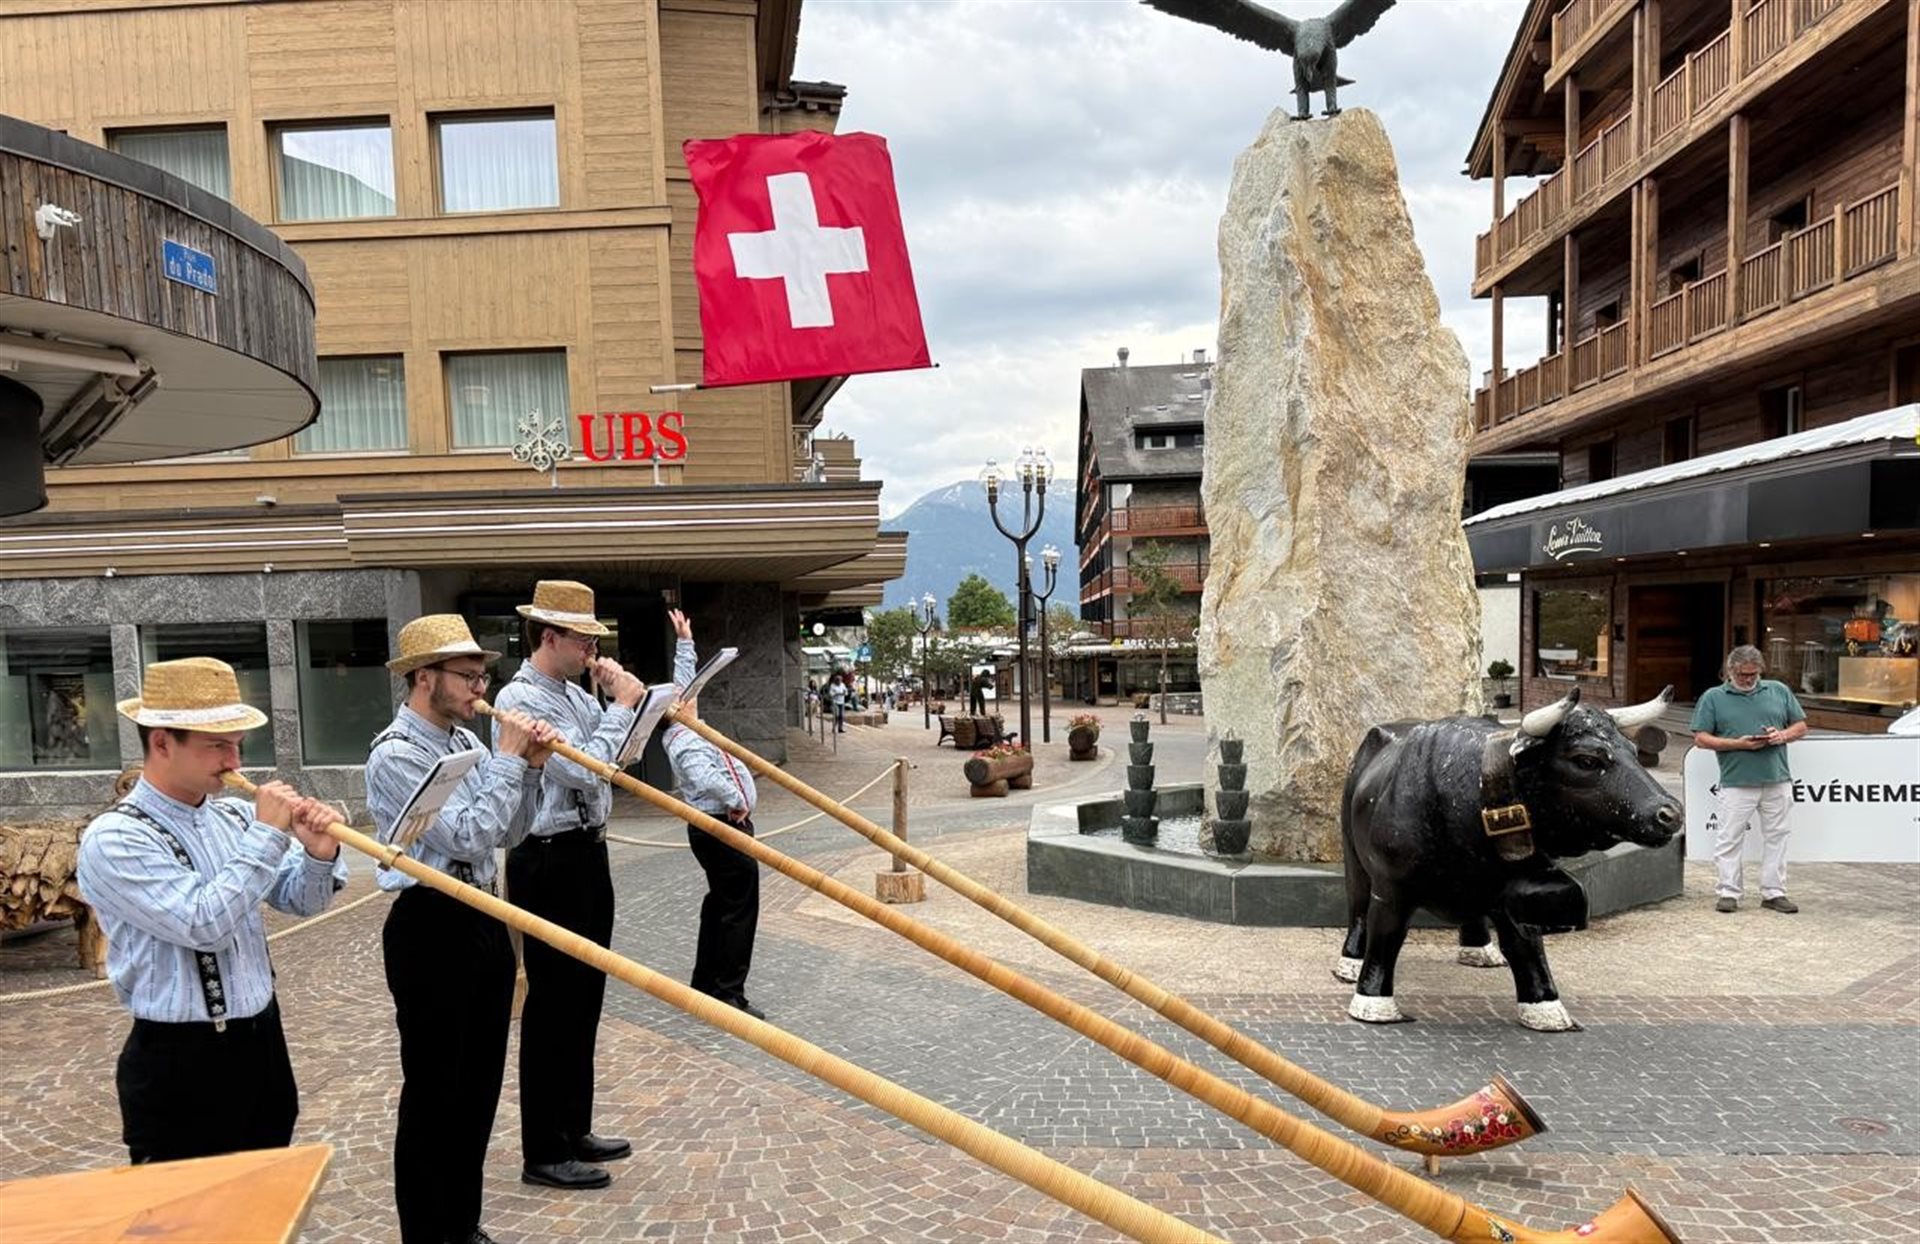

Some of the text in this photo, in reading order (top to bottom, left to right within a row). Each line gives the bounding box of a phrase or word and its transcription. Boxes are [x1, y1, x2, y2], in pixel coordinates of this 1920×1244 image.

[169, 255, 213, 289] du Prado
[577, 411, 688, 462] UBS
[1543, 517, 1602, 556] Louis Vuitton
[1792, 779, 1920, 802] ÉVÉNEME
